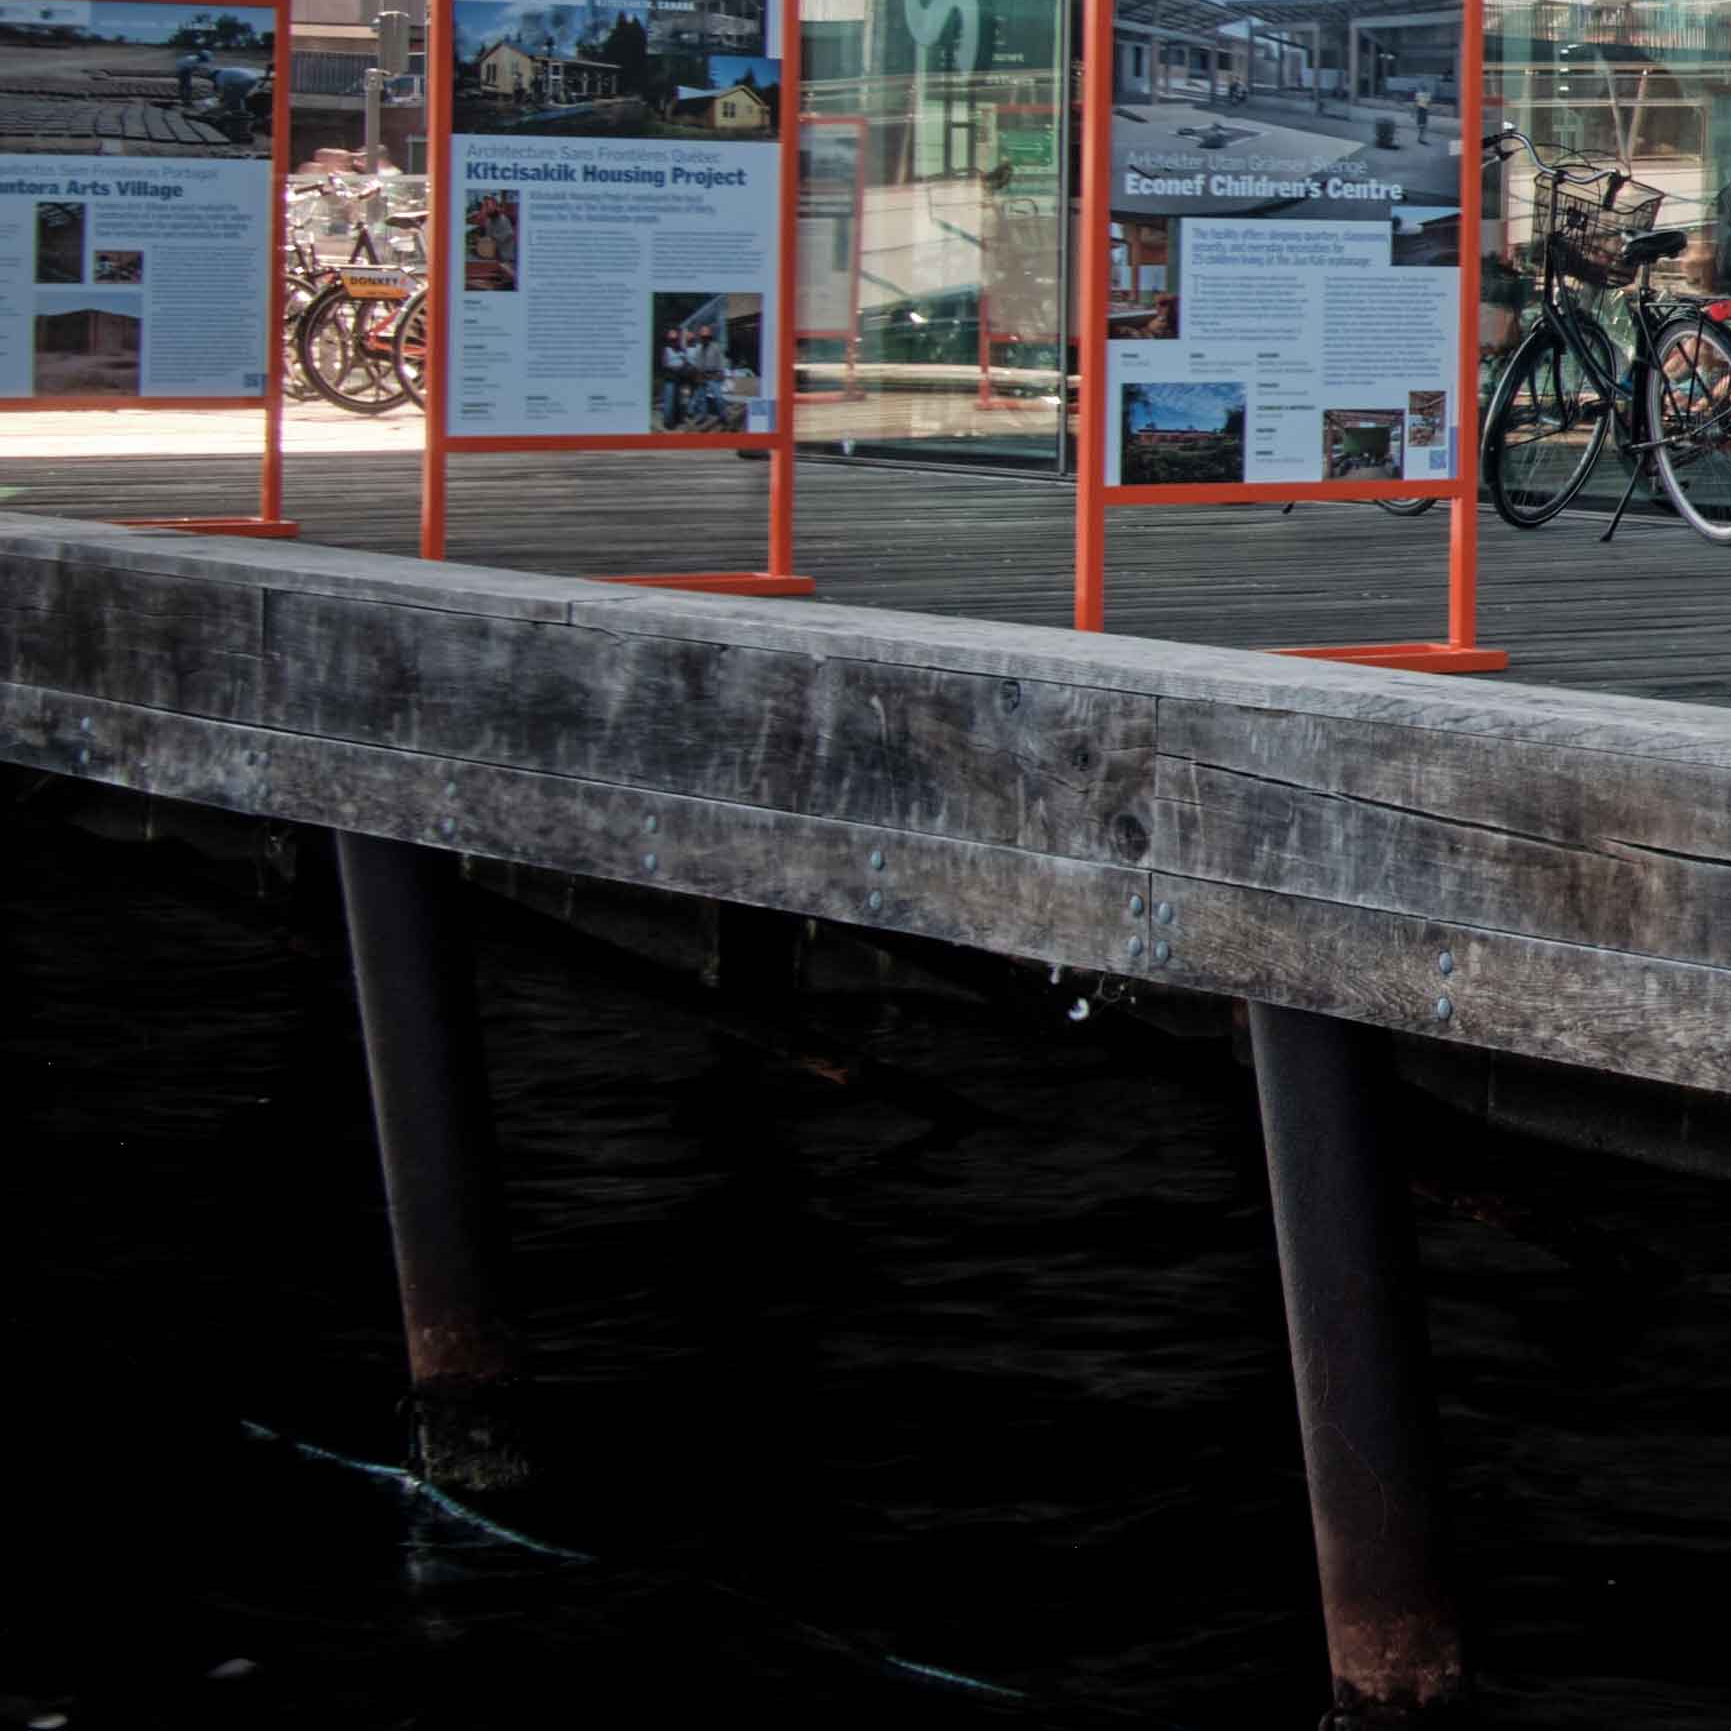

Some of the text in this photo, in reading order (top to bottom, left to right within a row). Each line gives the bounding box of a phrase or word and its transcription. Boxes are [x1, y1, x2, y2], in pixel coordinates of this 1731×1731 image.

[466, 162, 747, 190] Kitcisakik Housing Project
[1125, 173, 1403, 200] Econef Children's Centre
[66, 180, 110, 196] Arts
[117, 180, 184, 200] Village
